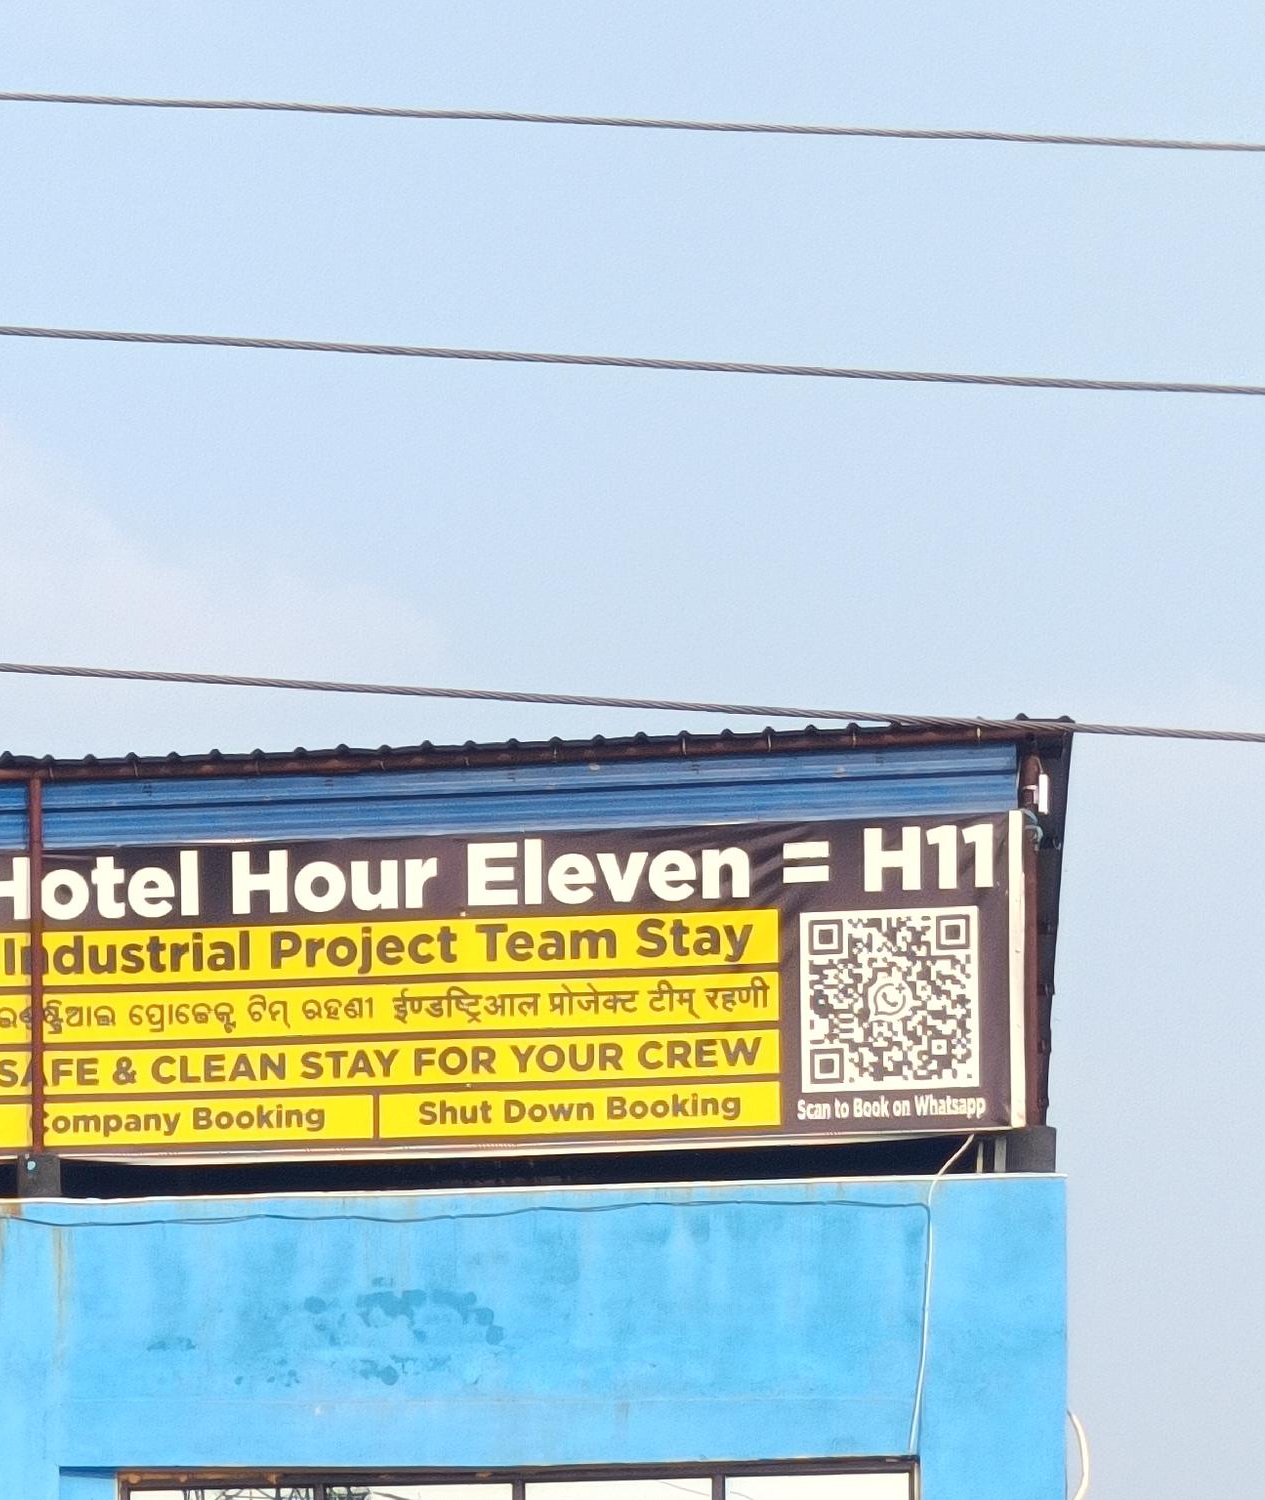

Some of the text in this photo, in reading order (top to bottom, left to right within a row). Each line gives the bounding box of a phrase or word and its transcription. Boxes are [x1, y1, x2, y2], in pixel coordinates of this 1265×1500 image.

[231, 849, 438, 915] Hour
[467, 838, 751, 907] Eleven
[783, 841, 830, 884] =
[864, 823, 994, 893] H11
[4, 918, 754, 976] Industrial Project Team Stay
[548, 982, 640, 1017] प्रोजेक्ट
[704, 976, 771, 1014] रहणी
[112, 1056, 137, 1086] &
[151, 1052, 287, 1085] CLEAN
[300, 1049, 400, 1081] STAY
[414, 1045, 497, 1076] FOR
[511, 1041, 624, 1074] YOUR
[638, 1036, 762, 1069] CREW
[192, 1104, 326, 1132] Booking
[419, 1093, 742, 1126] Shut Down Booking
[797, 1094, 987, 1121] Scan to Book on Whatsapp
